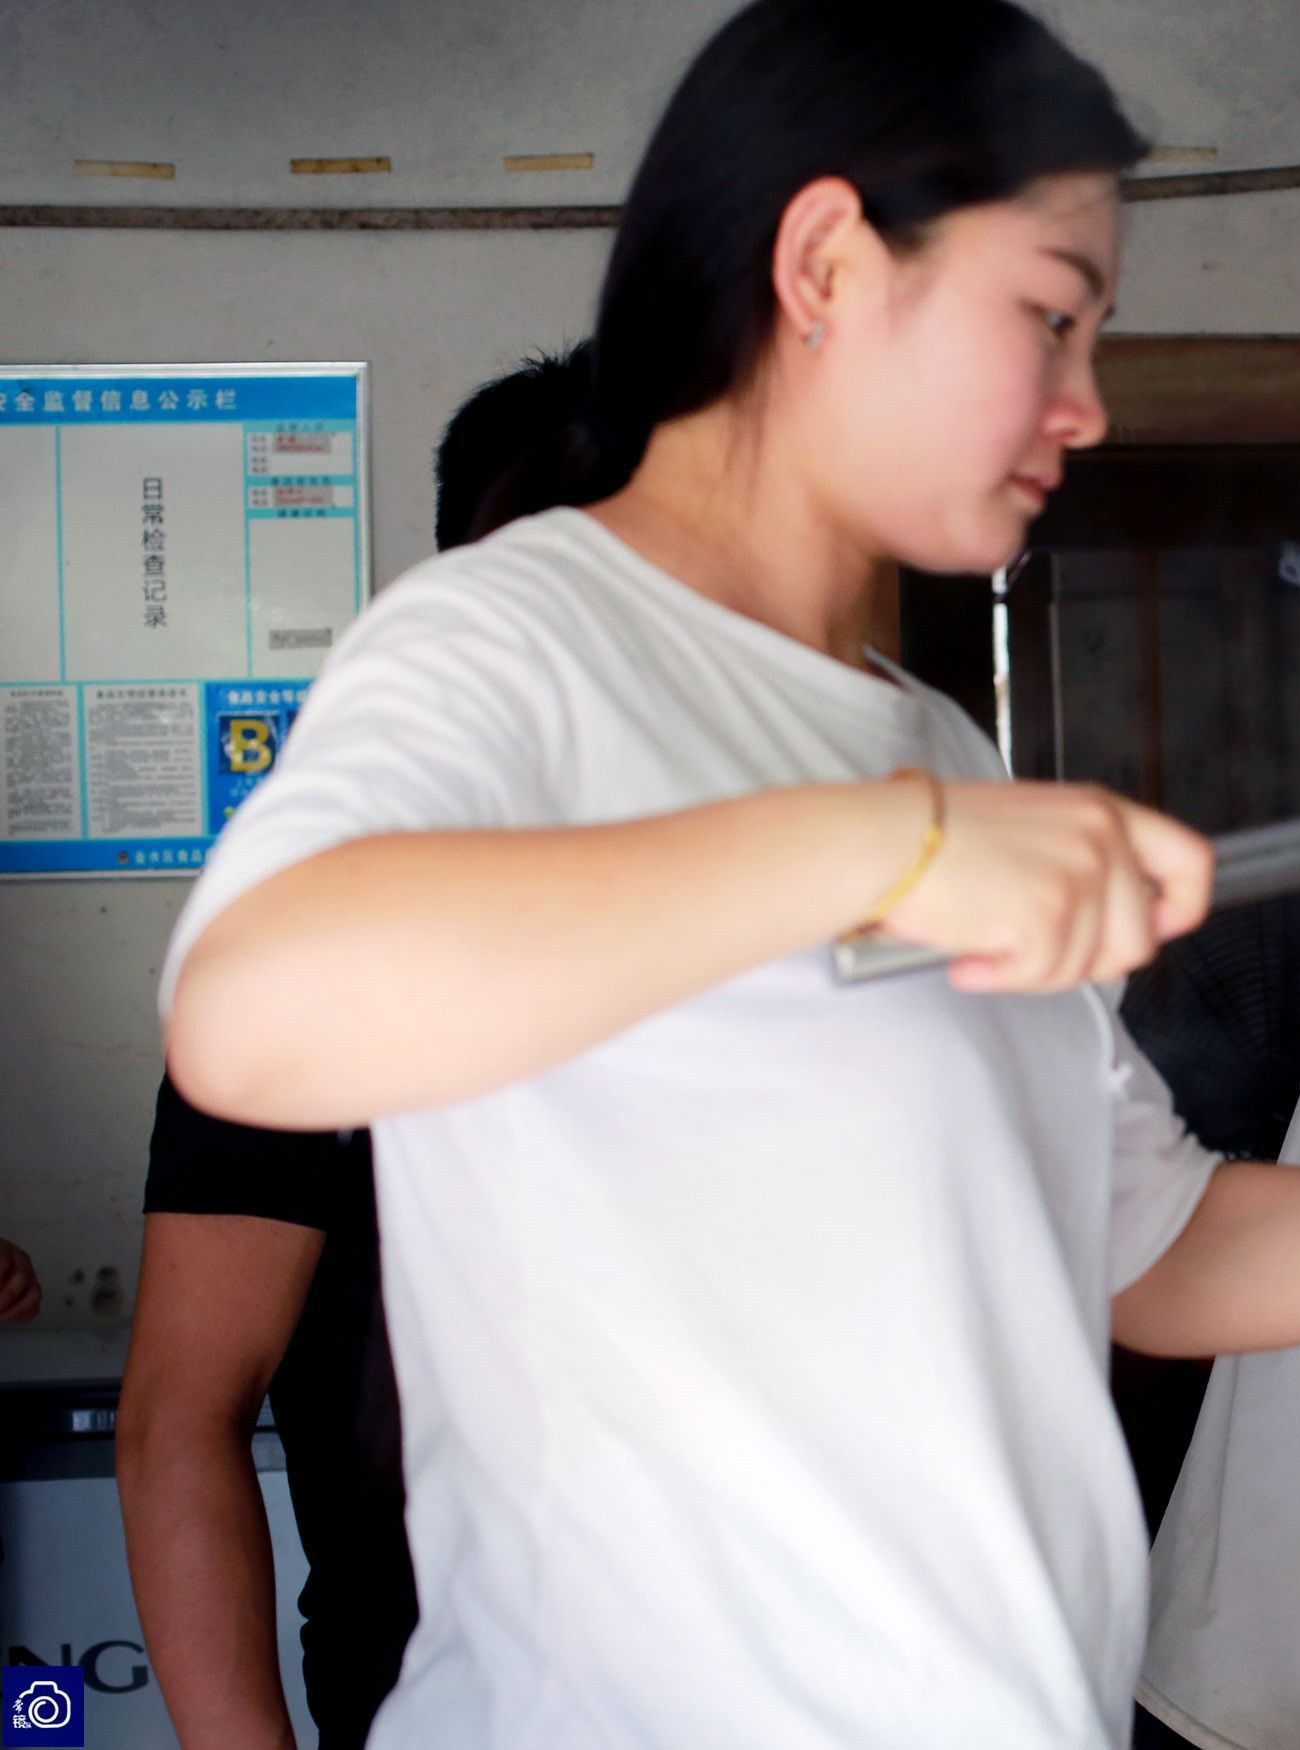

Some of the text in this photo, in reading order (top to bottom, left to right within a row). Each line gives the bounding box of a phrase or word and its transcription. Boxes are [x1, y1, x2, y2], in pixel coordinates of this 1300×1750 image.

[141, 477, 167, 628] 日常检查记录
[229, 718, 273, 774] B
